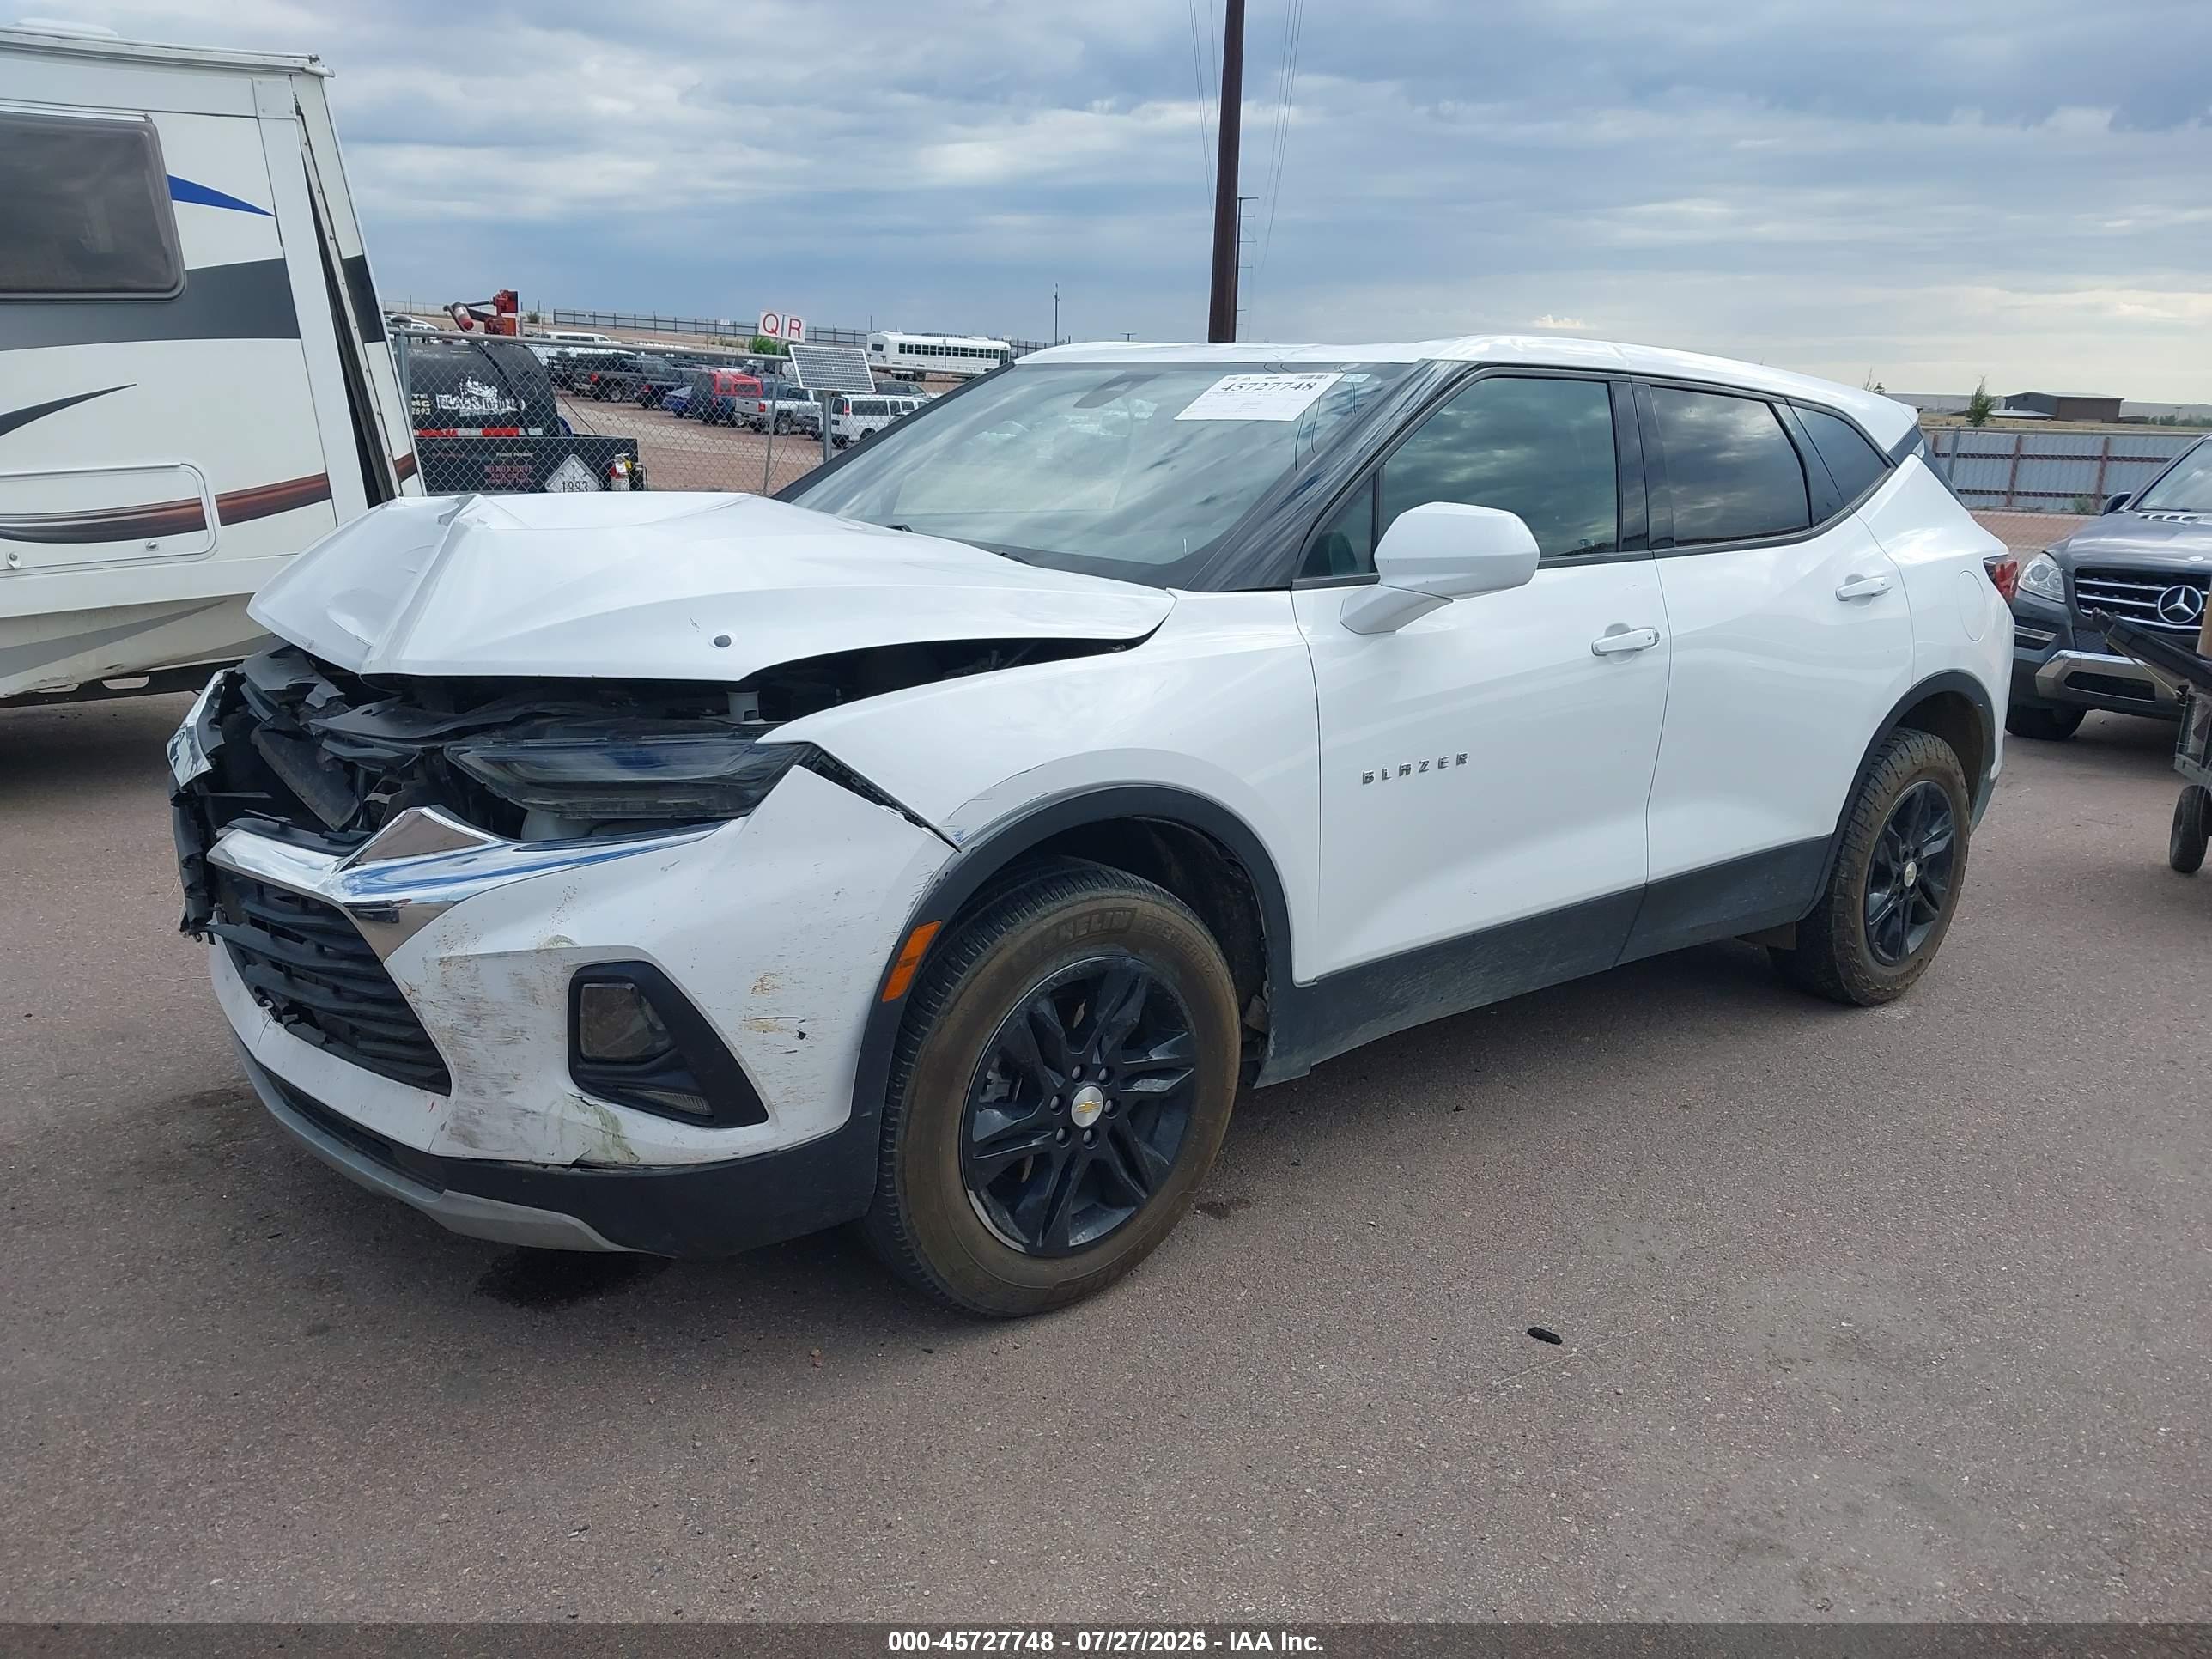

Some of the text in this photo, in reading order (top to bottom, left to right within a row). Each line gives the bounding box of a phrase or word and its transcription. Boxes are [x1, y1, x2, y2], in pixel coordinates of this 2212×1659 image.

[763, 313, 802, 338] Q R
[1221, 381, 1317, 391] 45727748
[1362, 752, 1468, 785] BLAZER
